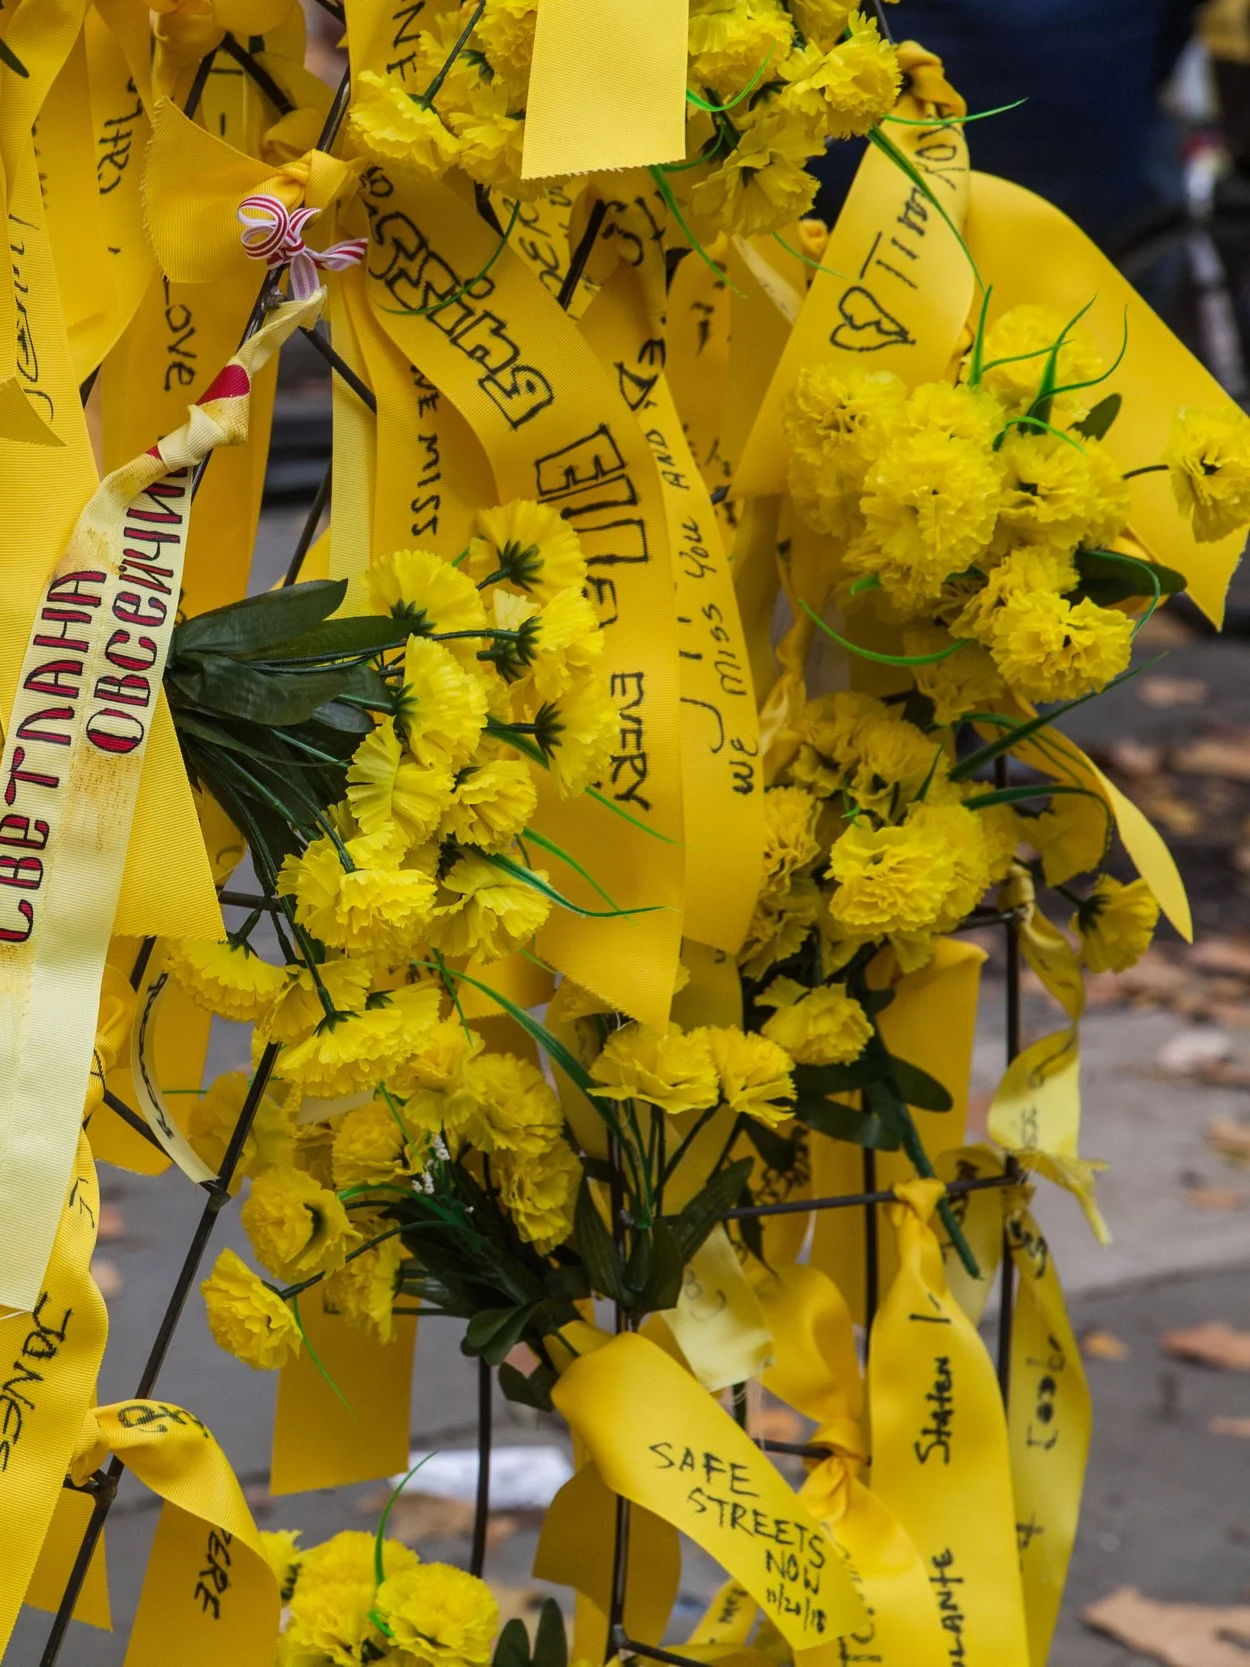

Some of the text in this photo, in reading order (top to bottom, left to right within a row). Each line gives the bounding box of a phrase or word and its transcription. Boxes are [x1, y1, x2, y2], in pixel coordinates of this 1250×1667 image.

[411, 433, 441, 536] MISS
[649, 1438, 760, 1500] SAFE
[687, 1485, 826, 1571] STREETS
[764, 1549, 822, 1597] NOW
